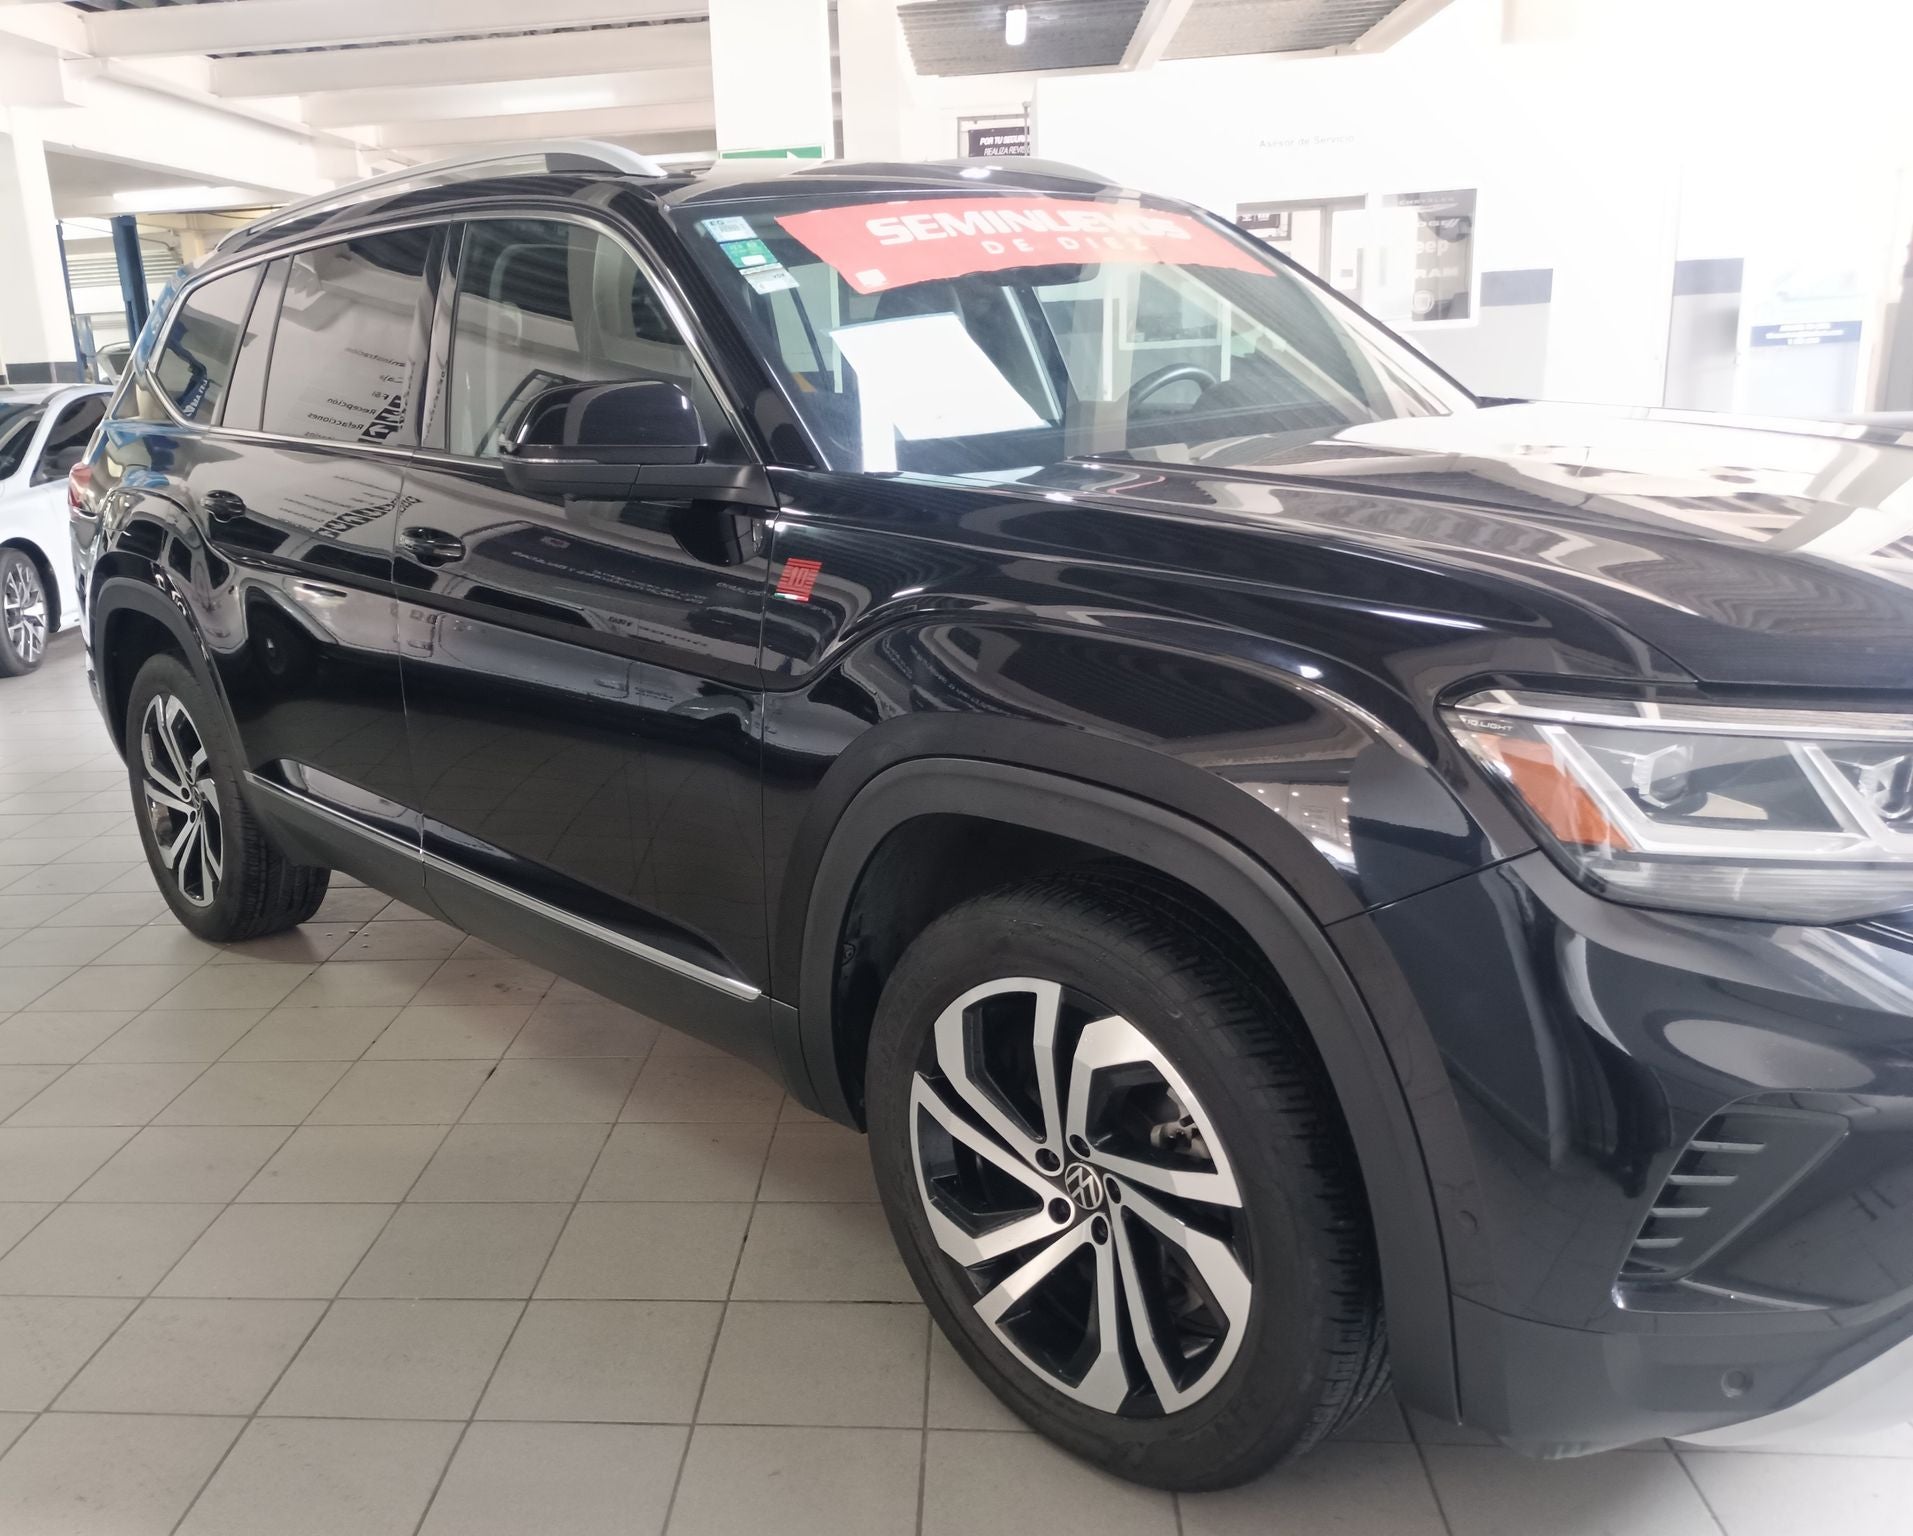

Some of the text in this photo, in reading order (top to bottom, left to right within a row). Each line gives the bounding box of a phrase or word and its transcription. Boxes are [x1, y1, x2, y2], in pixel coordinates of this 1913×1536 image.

[980, 136, 994, 146] POR
[994, 135, 1003, 145] TU
[1259, 134, 1355, 148] Asesor de Servicio
[866, 211, 1192, 245] SEMINUEVOS
[980, 235, 1150, 255] DE DIEZ
